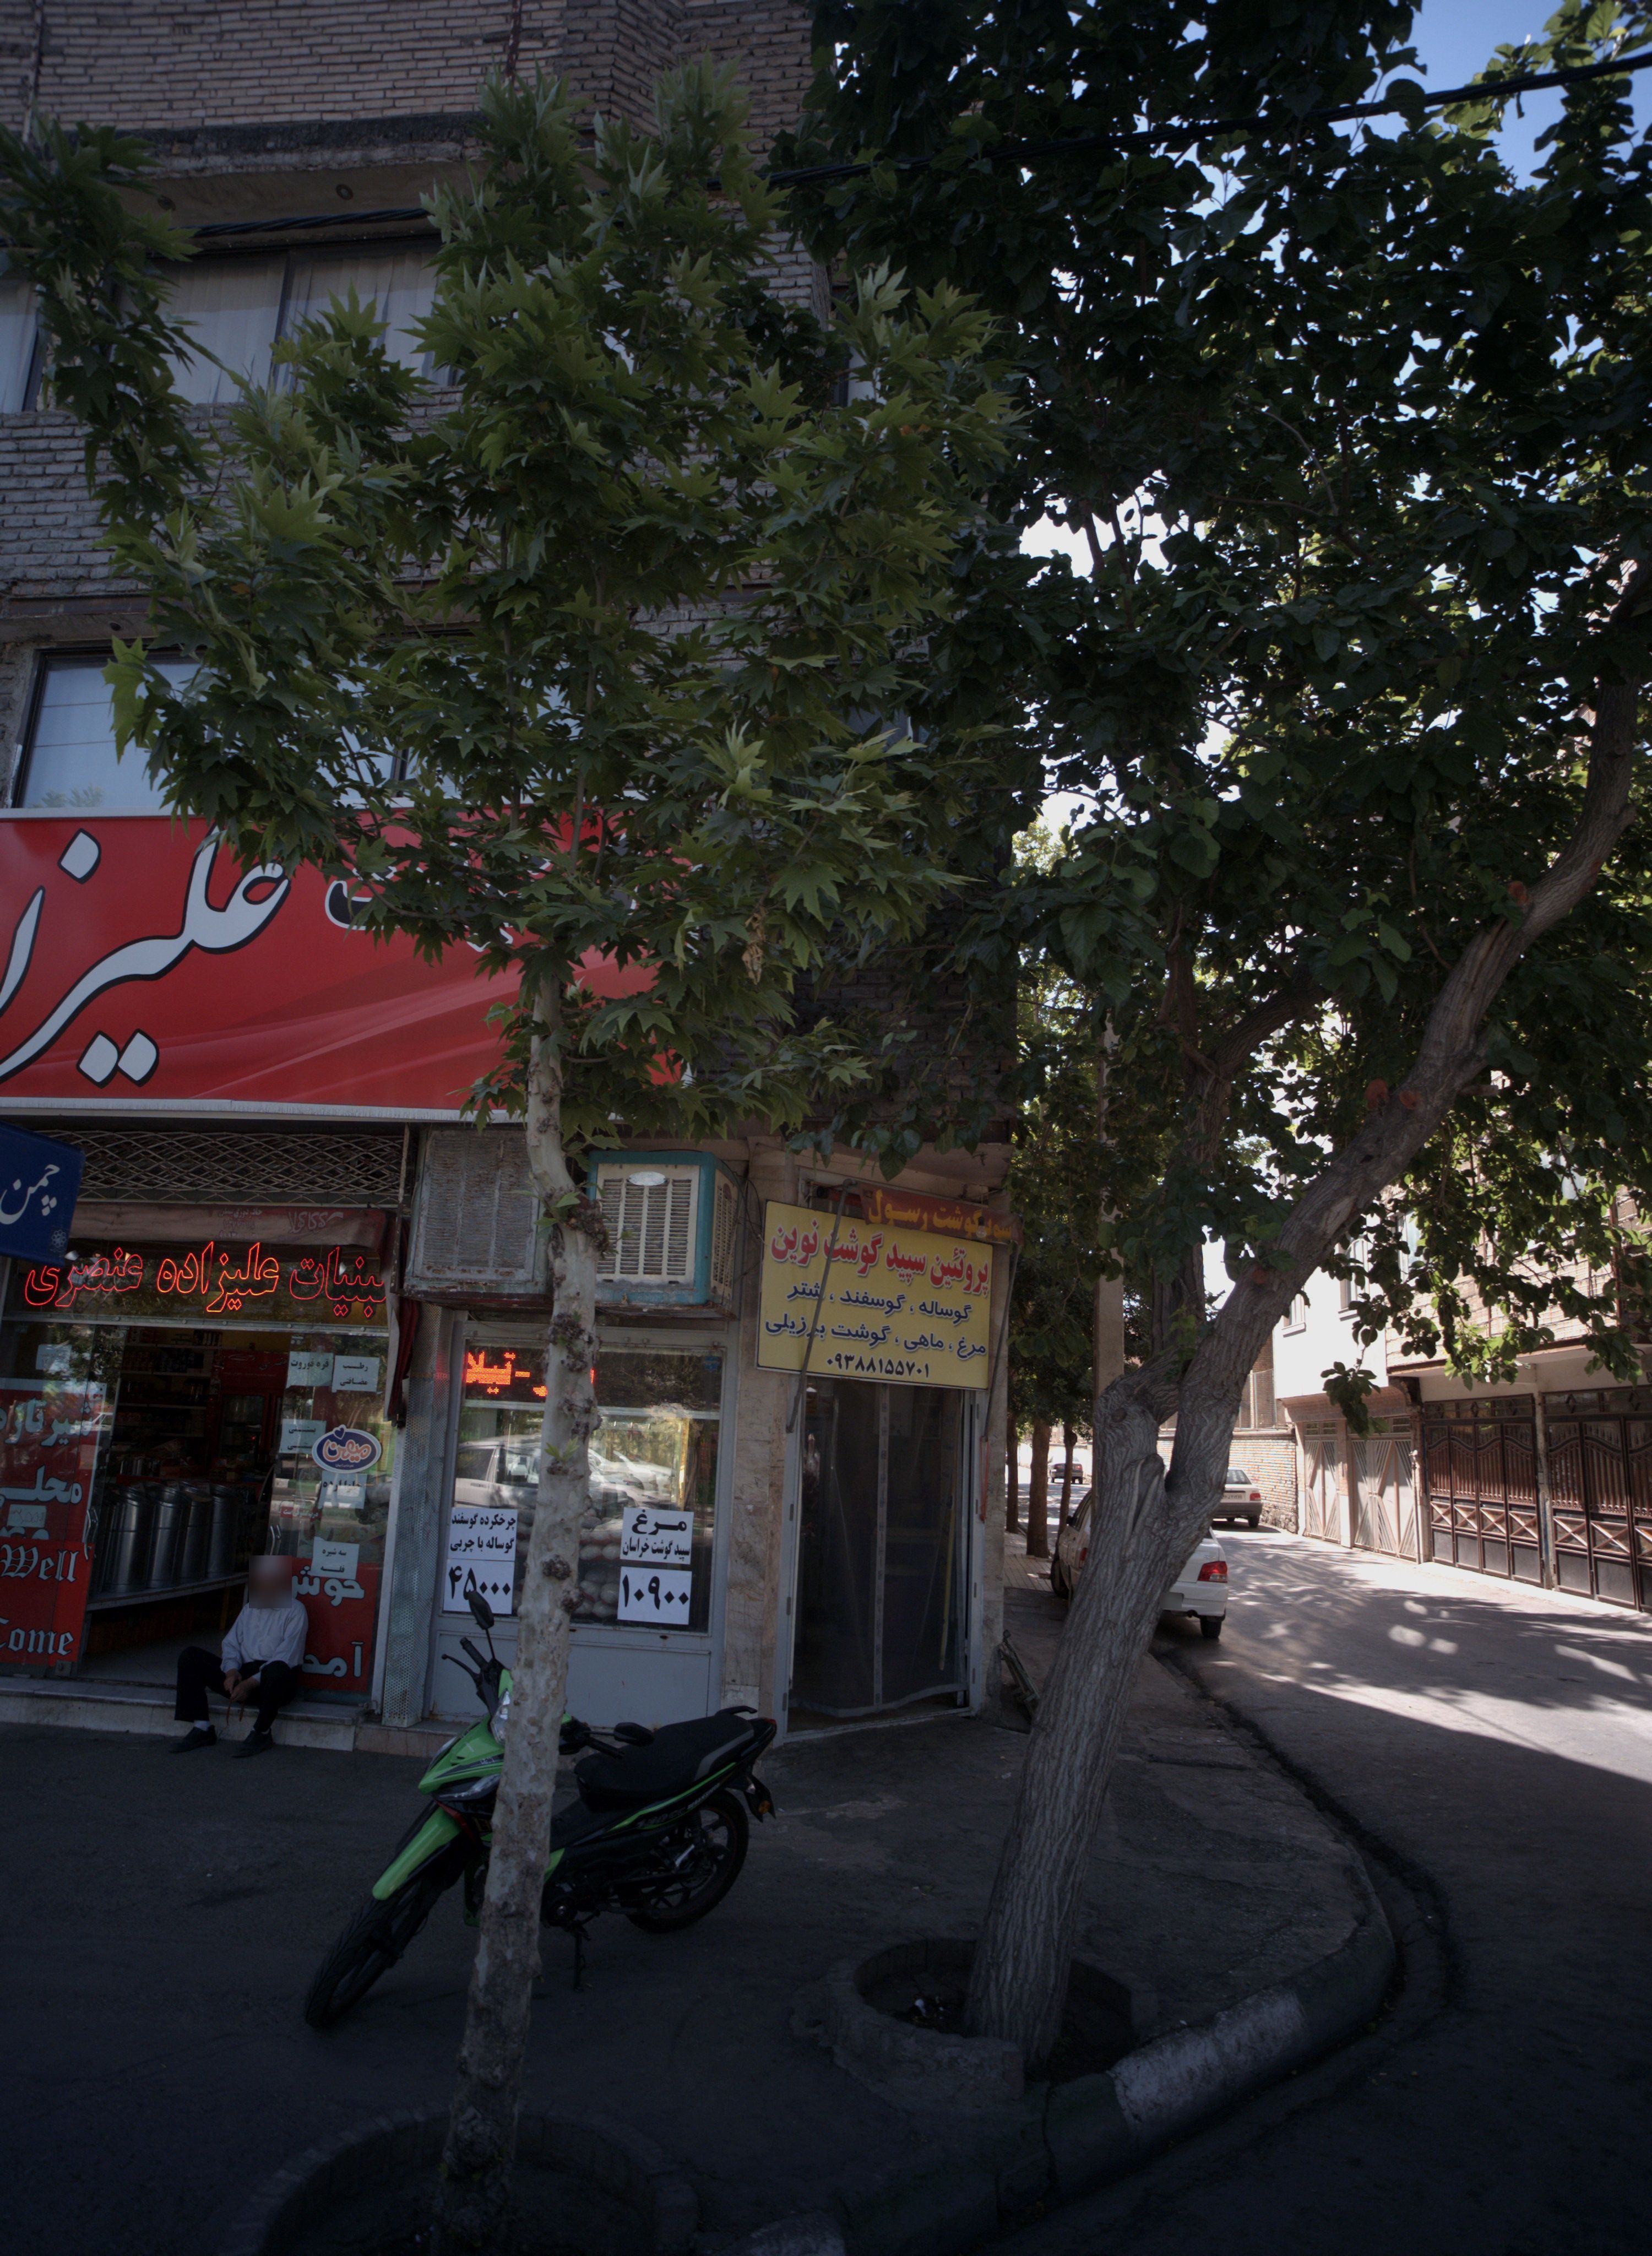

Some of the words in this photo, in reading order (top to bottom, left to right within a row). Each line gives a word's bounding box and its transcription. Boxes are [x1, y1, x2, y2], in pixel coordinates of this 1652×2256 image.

[0, 1163, 61, 1225] چمن
[868, 1189, 928, 1232] رسول
[932, 1206, 982, 1238] گوشت
[771, 1219, 818, 1266] نوین
[823, 1228, 883, 1276] گوشت
[886, 1243, 926, 1284] سپید
[930, 1247, 989, 1297] پروتئین
[24, 1246, 144, 1308] عنصری
[156, 1240, 280, 1313] علیزاده
[289, 1245, 386, 1317] بنیات
[786, 1282, 820, 1299] شتر
[840, 1290, 905, 1315] گوسفند
[919, 1300, 972, 1325] گوساله
[765, 1313, 825, 1338] برزیلی
[831, 1324, 891, 1347] گوشت
[904, 1333, 944, 1350] ماهی
[957, 1336, 986, 1359] مرغ
[343, 1362, 368, 1372] رطب
[827, 1352, 930, 1378] ۰۹۳۸۸۱۵۵۷۰۱
[40, 1402, 93, 1447] شیر
[322, 1439, 373, 1463] میهن
[0, 1465, 83, 1509] محل
[452, 1512, 479, 1530] گوسفند
[632, 1509, 687, 1536] مرغ
[450, 1538, 475, 1553] چربی
[477, 1536, 483, 1552] با
[486, 1536, 514, 1554] گوساله
[622, 1536, 650, 1558] خراسان
[651, 1540, 673, 1560] گوشت
[674, 1544, 690, 1561] سپید
[0, 1543, 80, 1583] Well
[622, 1574, 689, 1610] ۱۰۹۰۰
